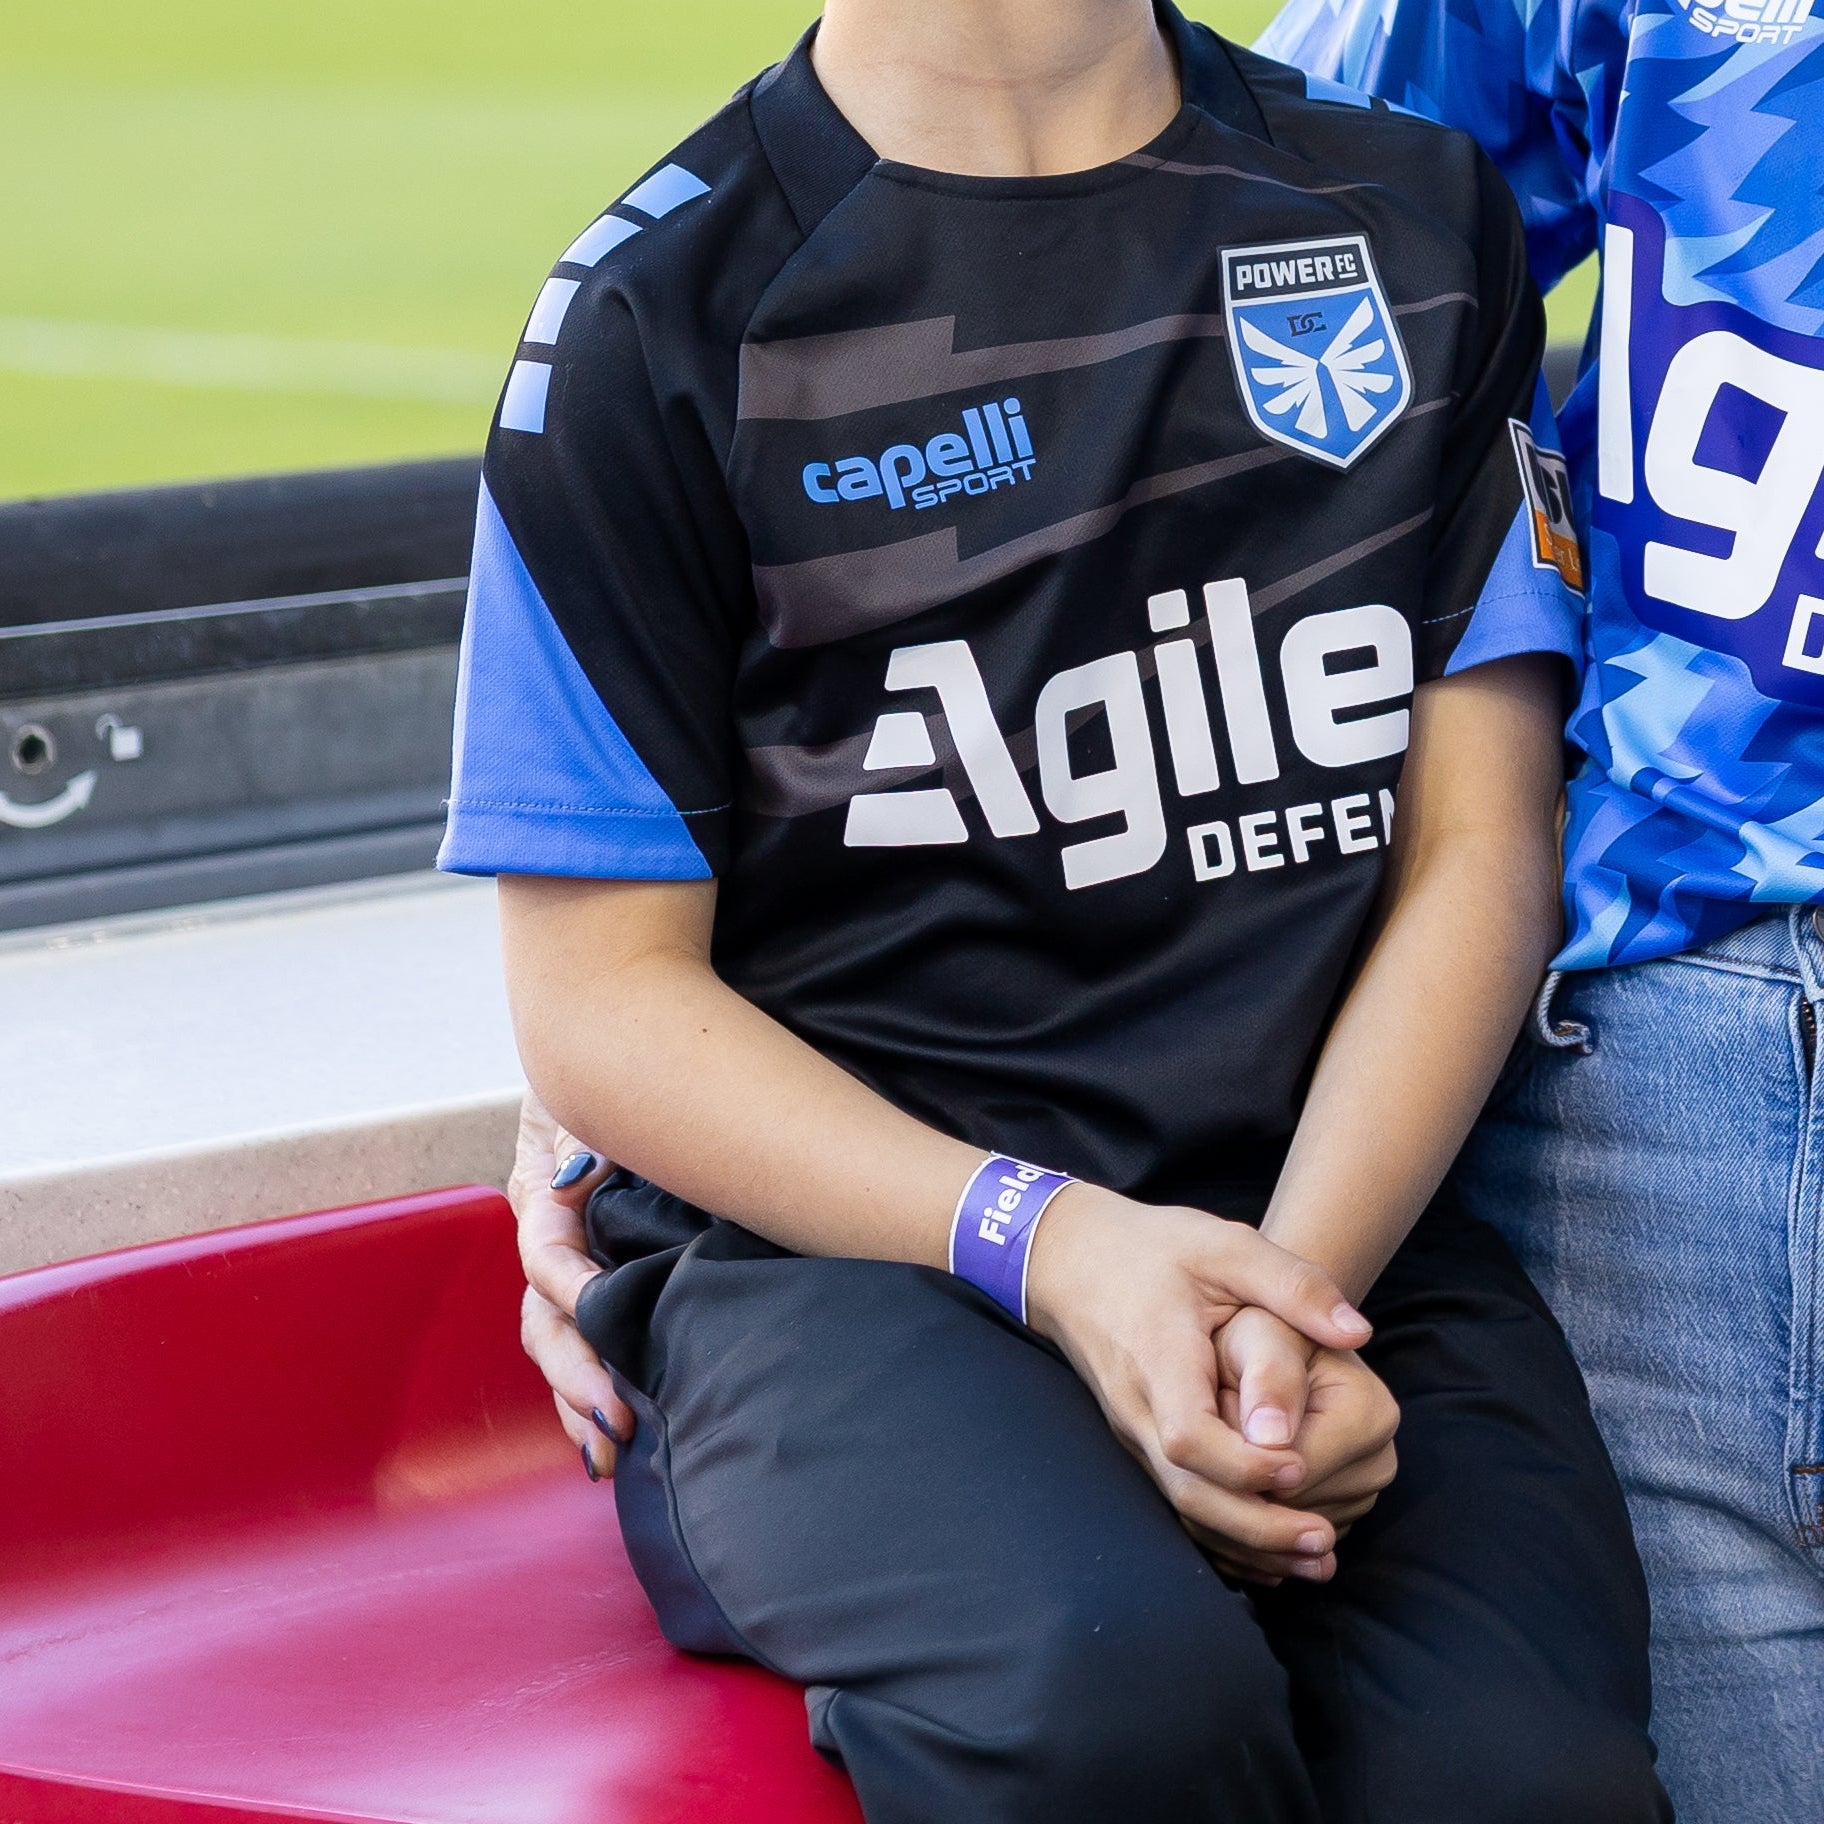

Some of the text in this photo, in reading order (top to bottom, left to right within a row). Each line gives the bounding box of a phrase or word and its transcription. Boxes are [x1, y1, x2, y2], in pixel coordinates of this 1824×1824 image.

[1689, 7, 1802, 45] SPORT
[1236, 253, 1356, 291] POWER FC
[803, 397, 1034, 510] capelli
[912, 458, 1037, 510] SPORT
[843, 577, 1415, 891] Agile
[978, 1164, 1046, 1246] Field
